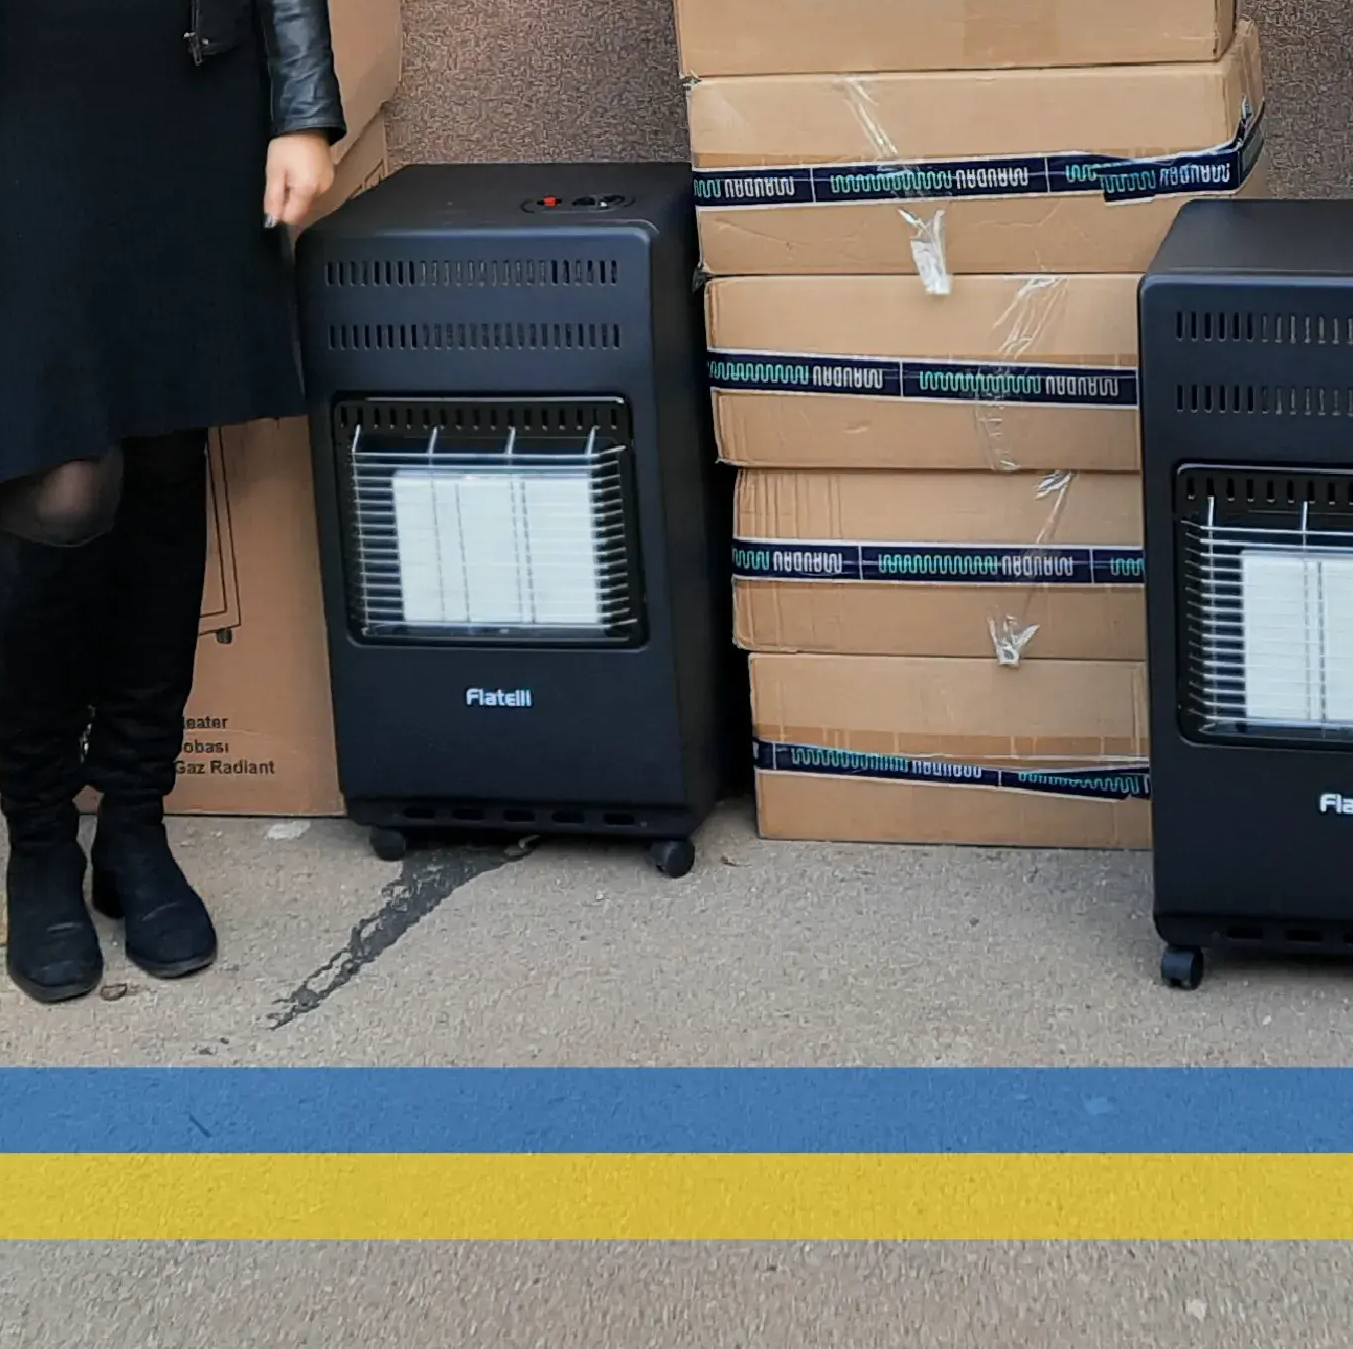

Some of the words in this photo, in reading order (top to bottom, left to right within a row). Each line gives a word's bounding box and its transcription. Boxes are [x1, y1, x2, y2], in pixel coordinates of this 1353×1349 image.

[183, 715, 228, 730] eater
[182, 739, 229, 754] obası
[174, 760, 205, 775] Gaz
[210, 759, 276, 775] Radiant
